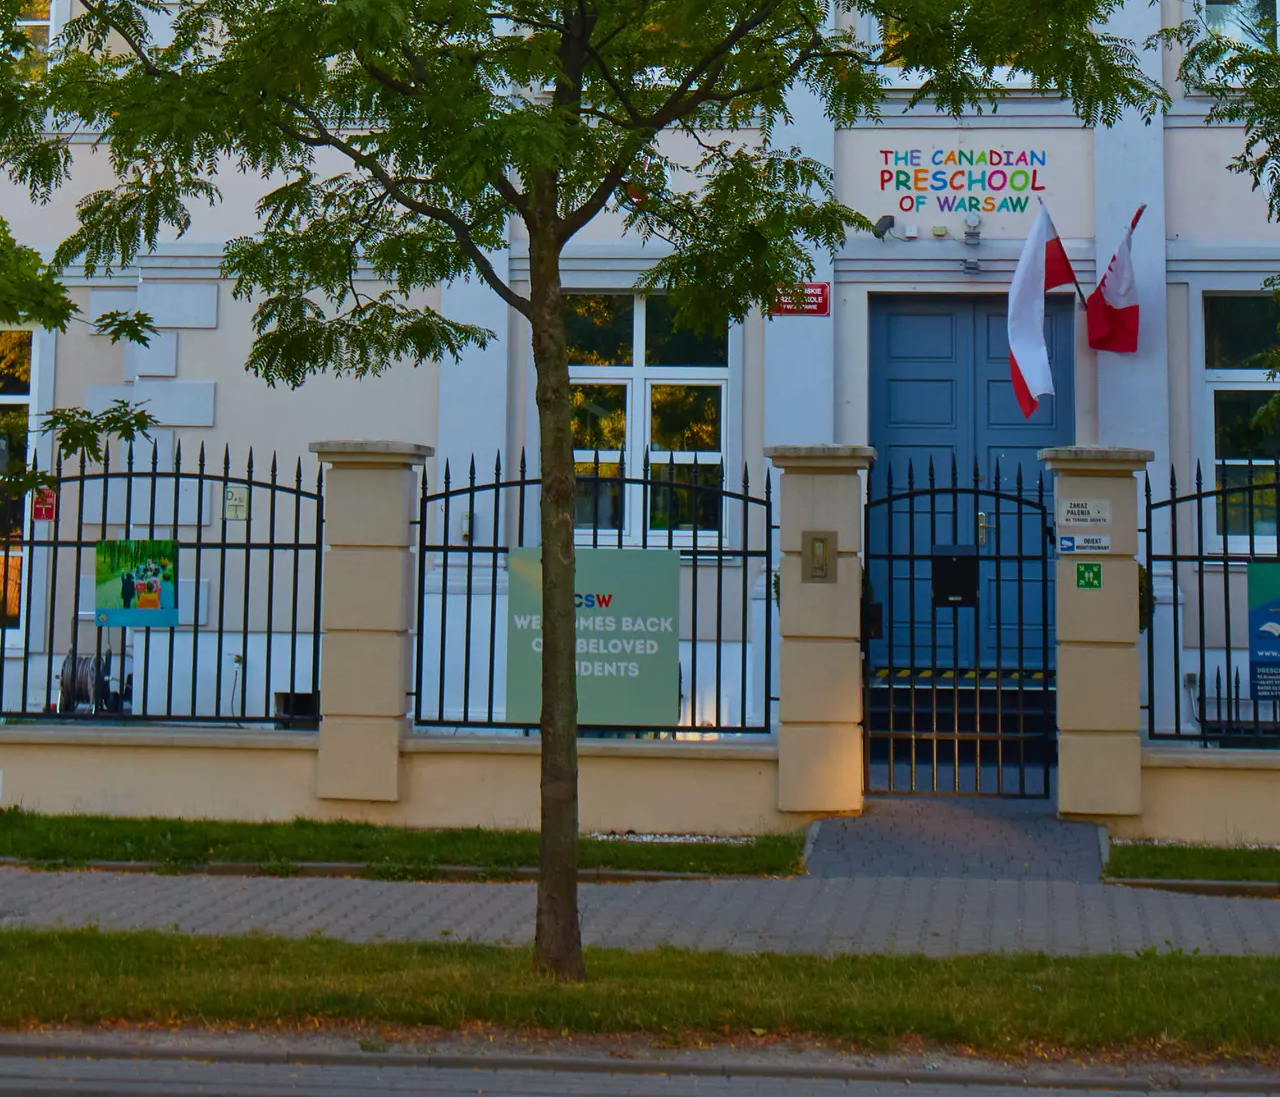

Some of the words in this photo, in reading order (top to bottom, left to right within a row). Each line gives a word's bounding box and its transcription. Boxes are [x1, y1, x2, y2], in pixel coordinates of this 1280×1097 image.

[880, 150, 922, 167] THE
[931, 150, 1047, 167] CANADIAN
[880, 168, 1046, 192] PRESCHOOL
[899, 195, 928, 213] OF
[936, 195, 1030, 214] WARSAW
[574, 594, 613, 608] CSW
[514, 615, 616, 632] WEMES
[622, 616, 673, 633] BACK
[576, 638, 659, 655] BELOVED
